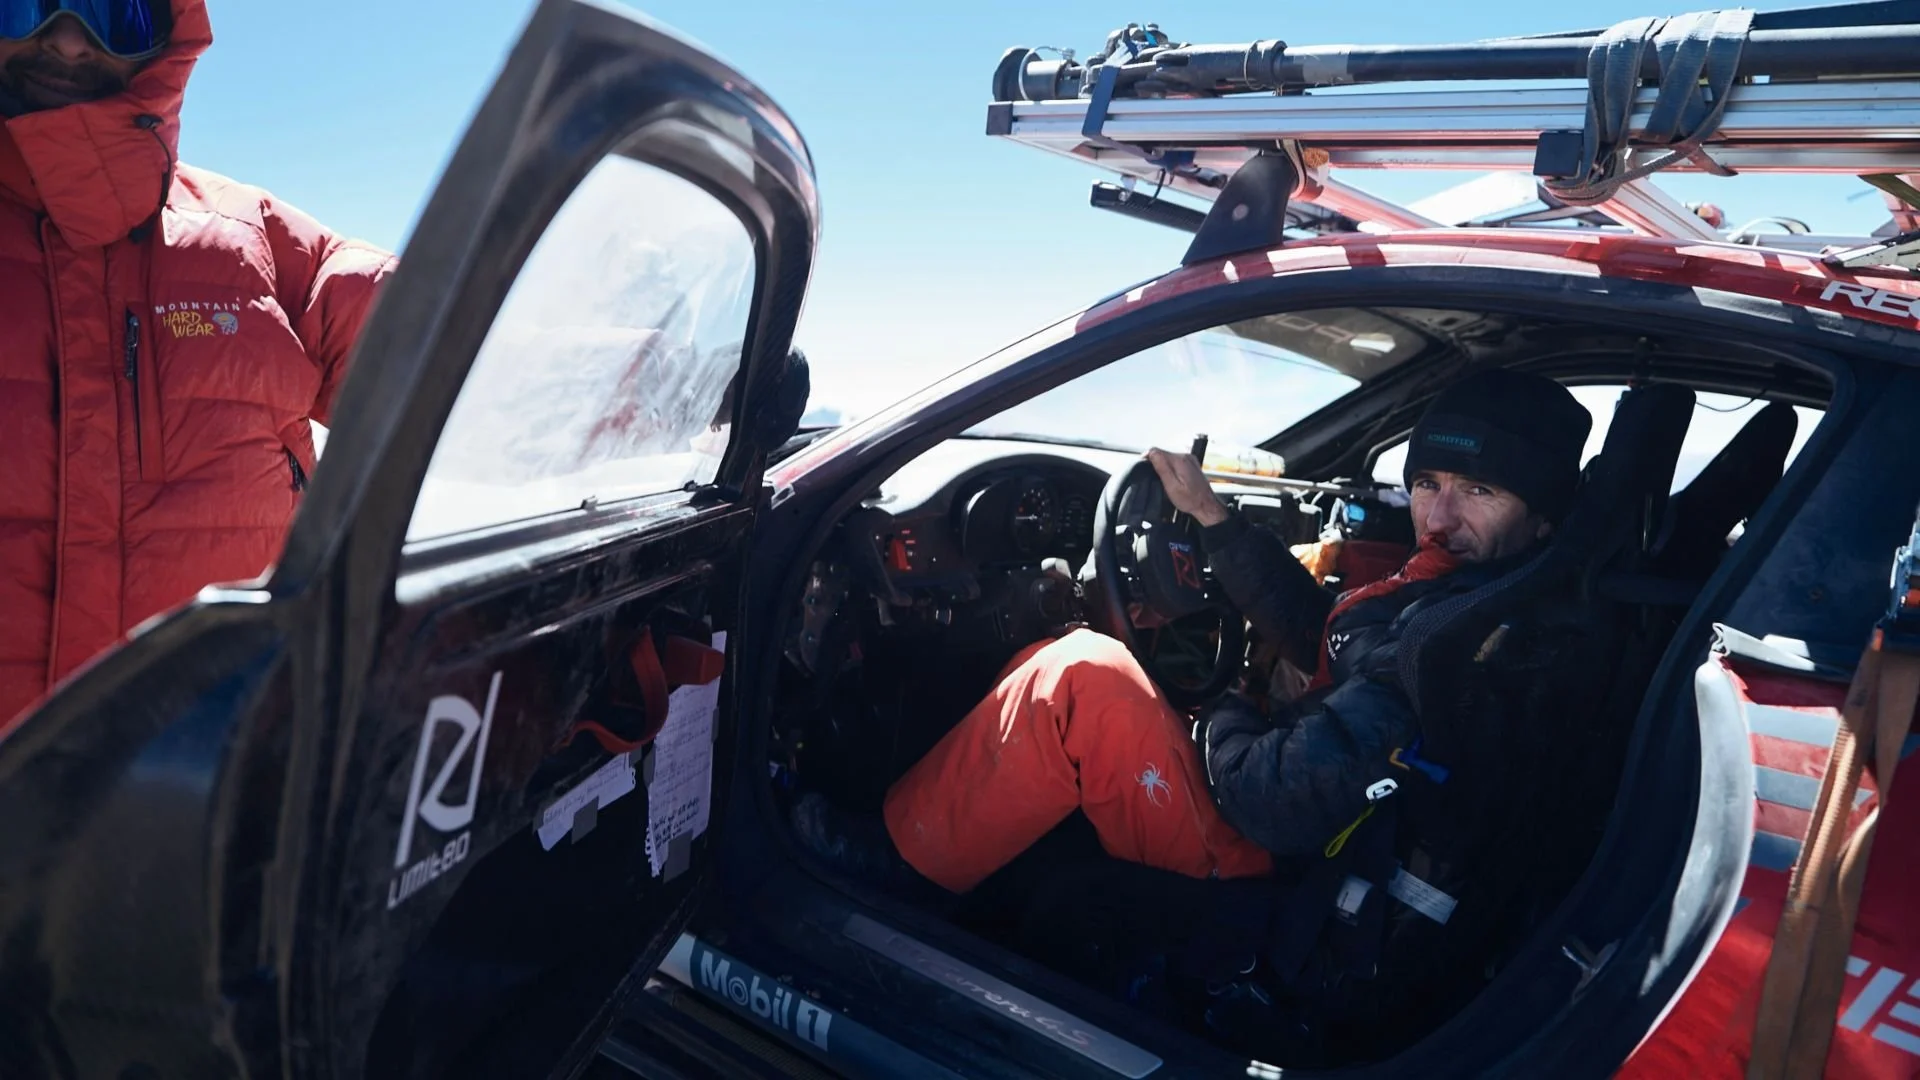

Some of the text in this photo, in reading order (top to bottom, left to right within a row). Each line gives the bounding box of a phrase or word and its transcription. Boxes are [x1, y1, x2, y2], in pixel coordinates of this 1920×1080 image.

[155, 302, 240, 314] MOUNTAIN
[1820, 280, 1920, 320] RE
[162, 311, 201, 327] HARD
[173, 323, 215, 338] WEAR
[701, 949, 793, 1026] Mobil
